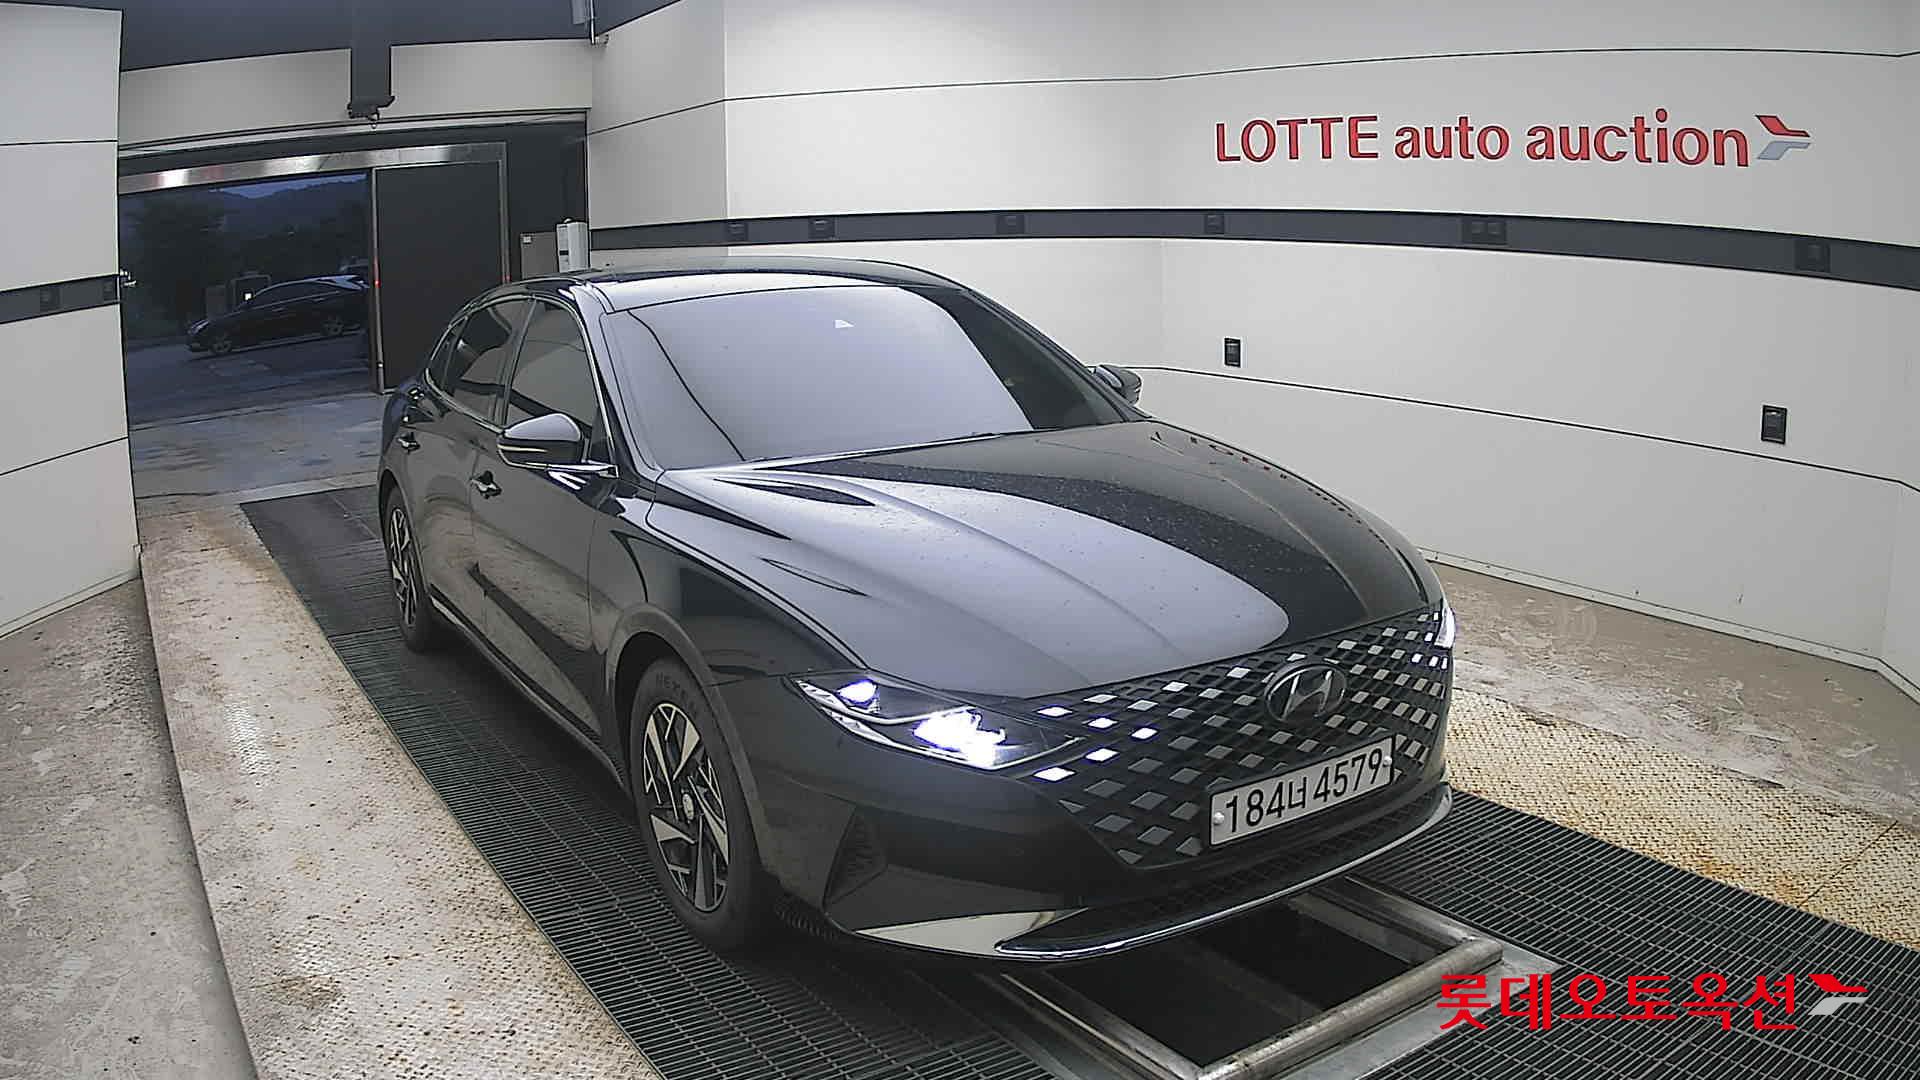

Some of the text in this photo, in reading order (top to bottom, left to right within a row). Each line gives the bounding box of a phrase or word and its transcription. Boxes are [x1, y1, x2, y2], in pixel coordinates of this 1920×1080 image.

[1215, 108, 1750, 167] LOTTE auto auction
